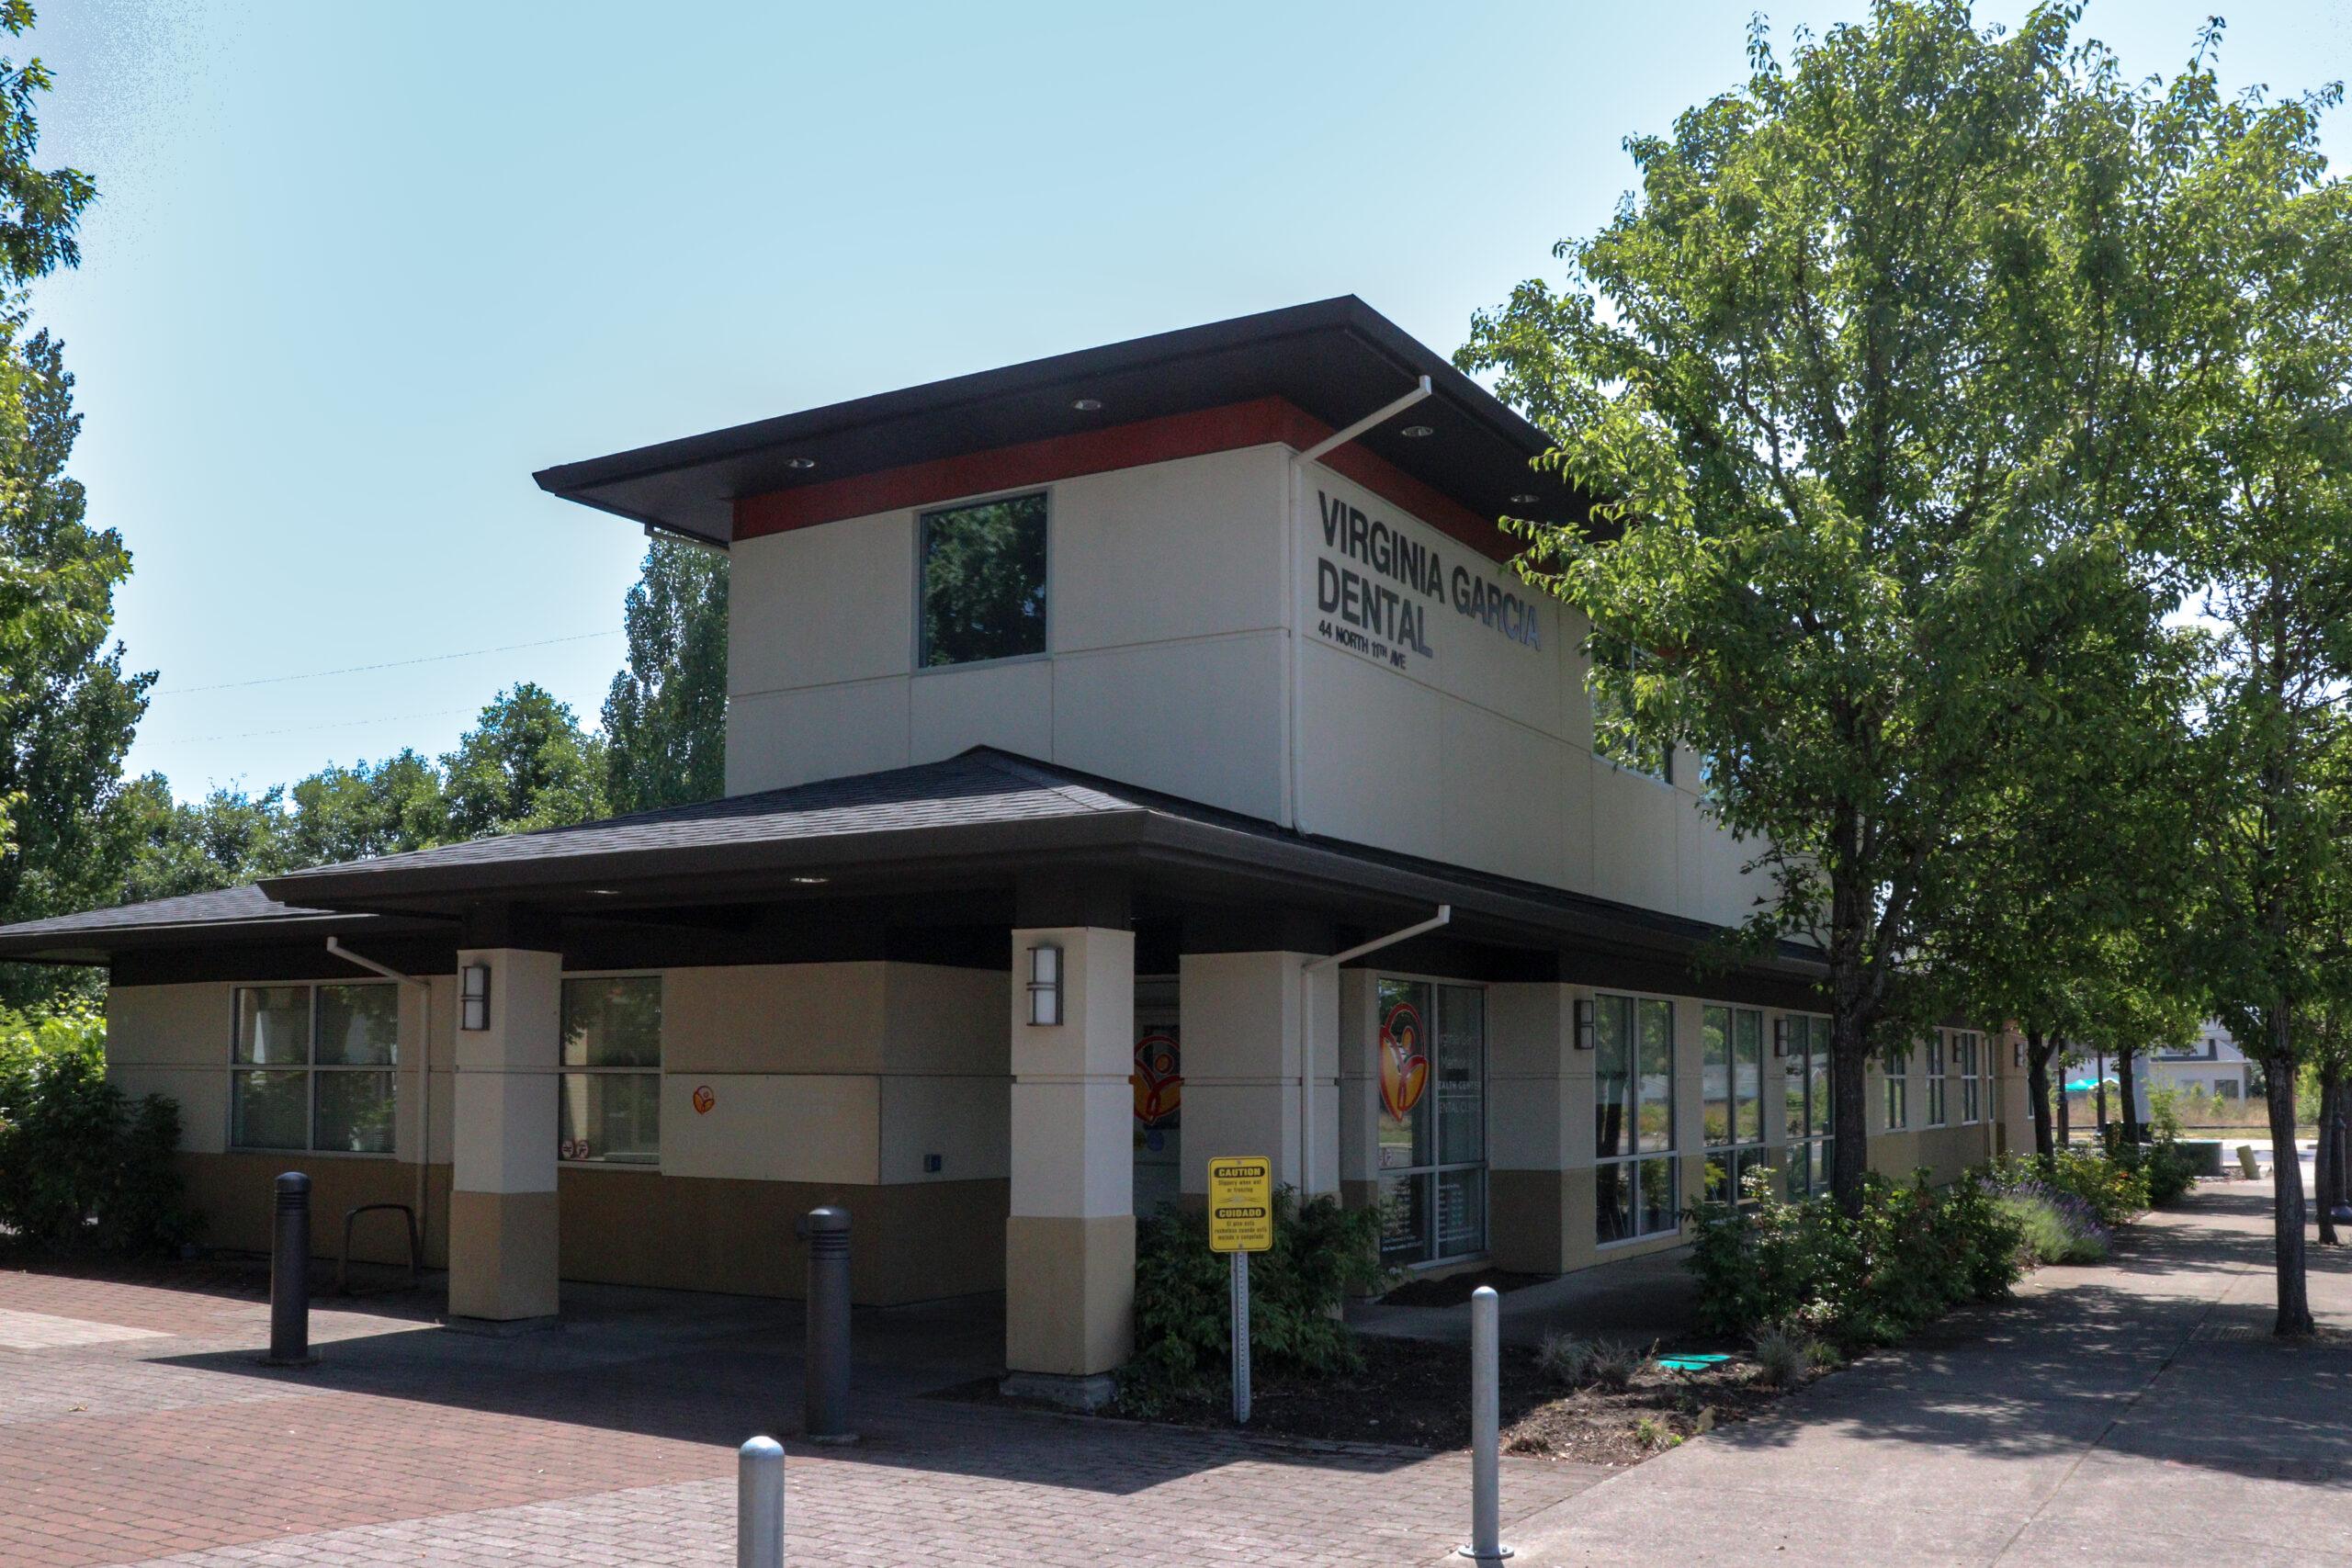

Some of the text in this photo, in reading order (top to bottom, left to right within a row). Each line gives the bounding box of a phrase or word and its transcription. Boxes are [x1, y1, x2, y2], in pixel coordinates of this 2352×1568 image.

[1317, 490, 1541, 652] VIRGINIA GARCIA
[1317, 557, 1433, 659] DENTAL
[1318, 619, 1332, 640] 44
[1336, 626, 1369, 654] NORTH
[1390, 649, 1407, 670] AVE
[1218, 1168, 1261, 1177] CAUTION
[1219, 1208, 1261, 1218] CUIDADO
